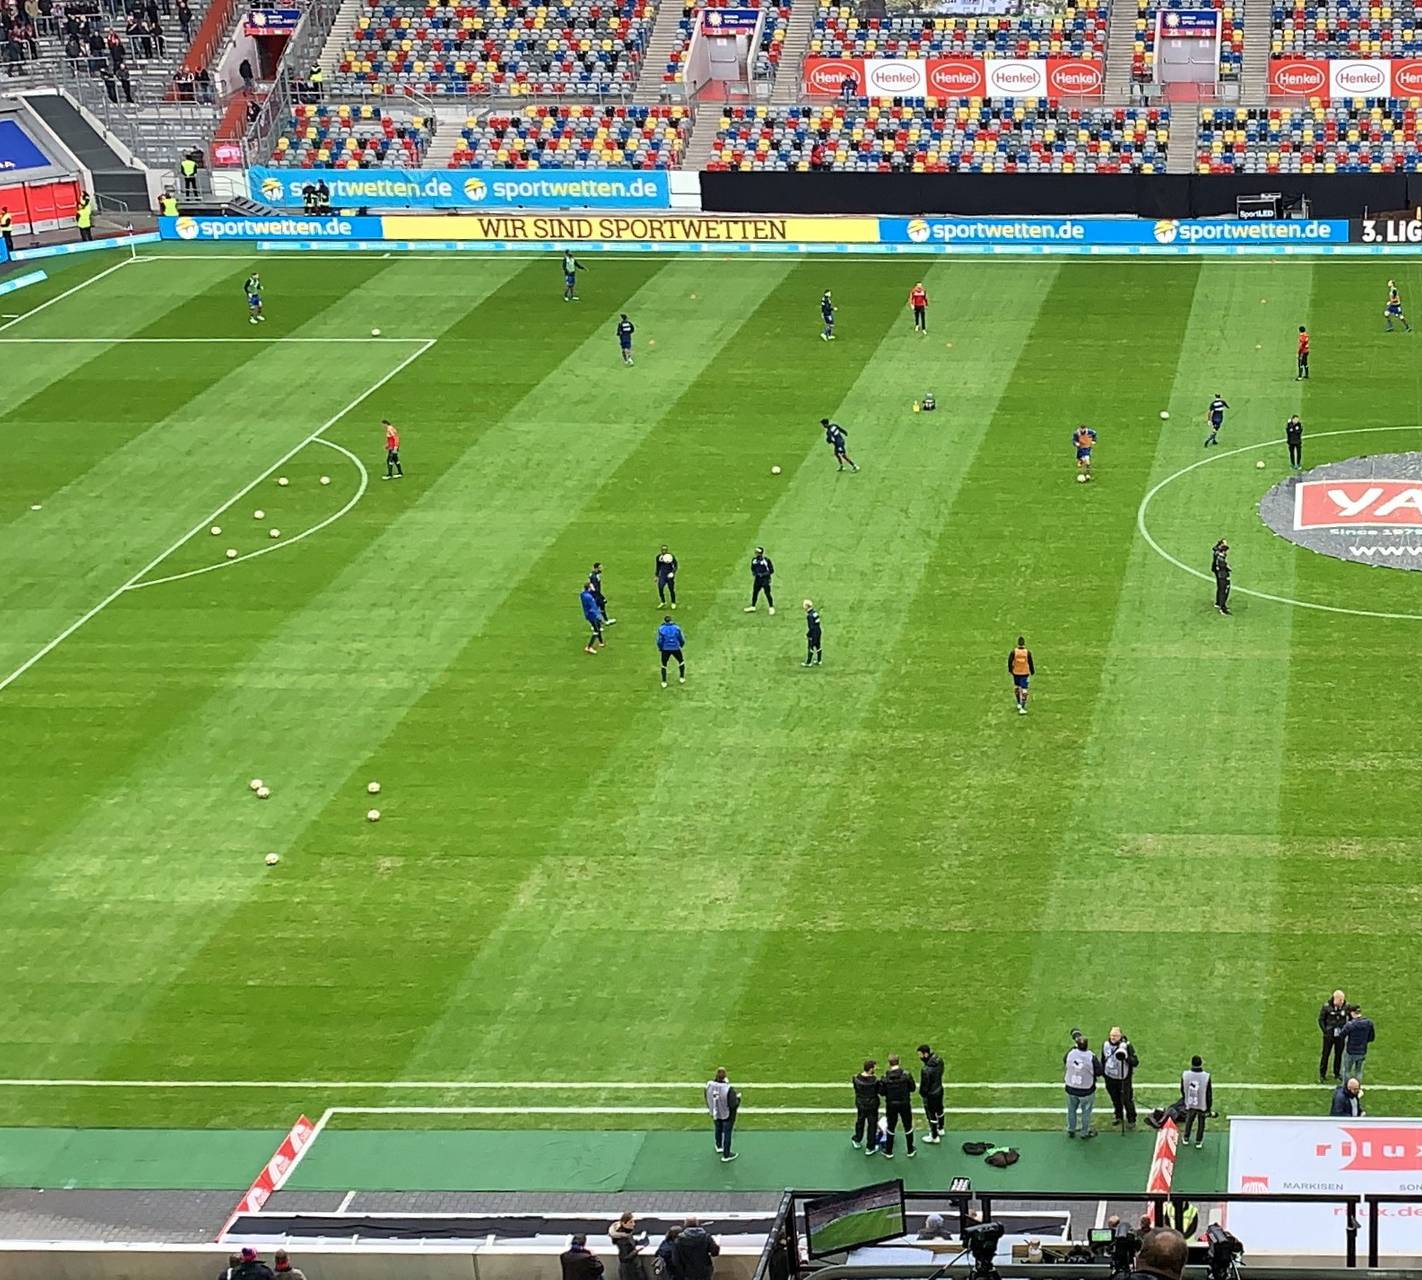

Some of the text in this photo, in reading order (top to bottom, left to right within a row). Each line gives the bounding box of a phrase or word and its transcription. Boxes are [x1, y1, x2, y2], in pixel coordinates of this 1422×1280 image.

[815, 72, 857, 83] Henkl
[876, 72, 916, 84] Henkel
[935, 72, 976, 84] Henkel
[996, 72, 1037, 84] Henkel
[1056, 72, 1097, 84] Henkel
[1279, 73, 1320, 84] Henkel
[1339, 73, 1380, 84] Henkel
[291, 179, 453, 200] srtwetten.de
[493, 178, 658, 201] sportwetten.de
[1239, 210, 1274, 219] SportLED
[200, 217, 352, 239] sportwetten.de
[477, 218, 787, 240] WIR SIND SPORTWETTEN
[932, 221, 1085, 242] sportwetten.de
[1179, 221, 1332, 243] sportwetten.de
[1361, 220, 1383, 242] 3.
[1282, 1182, 1344, 1191] MARKISEN
